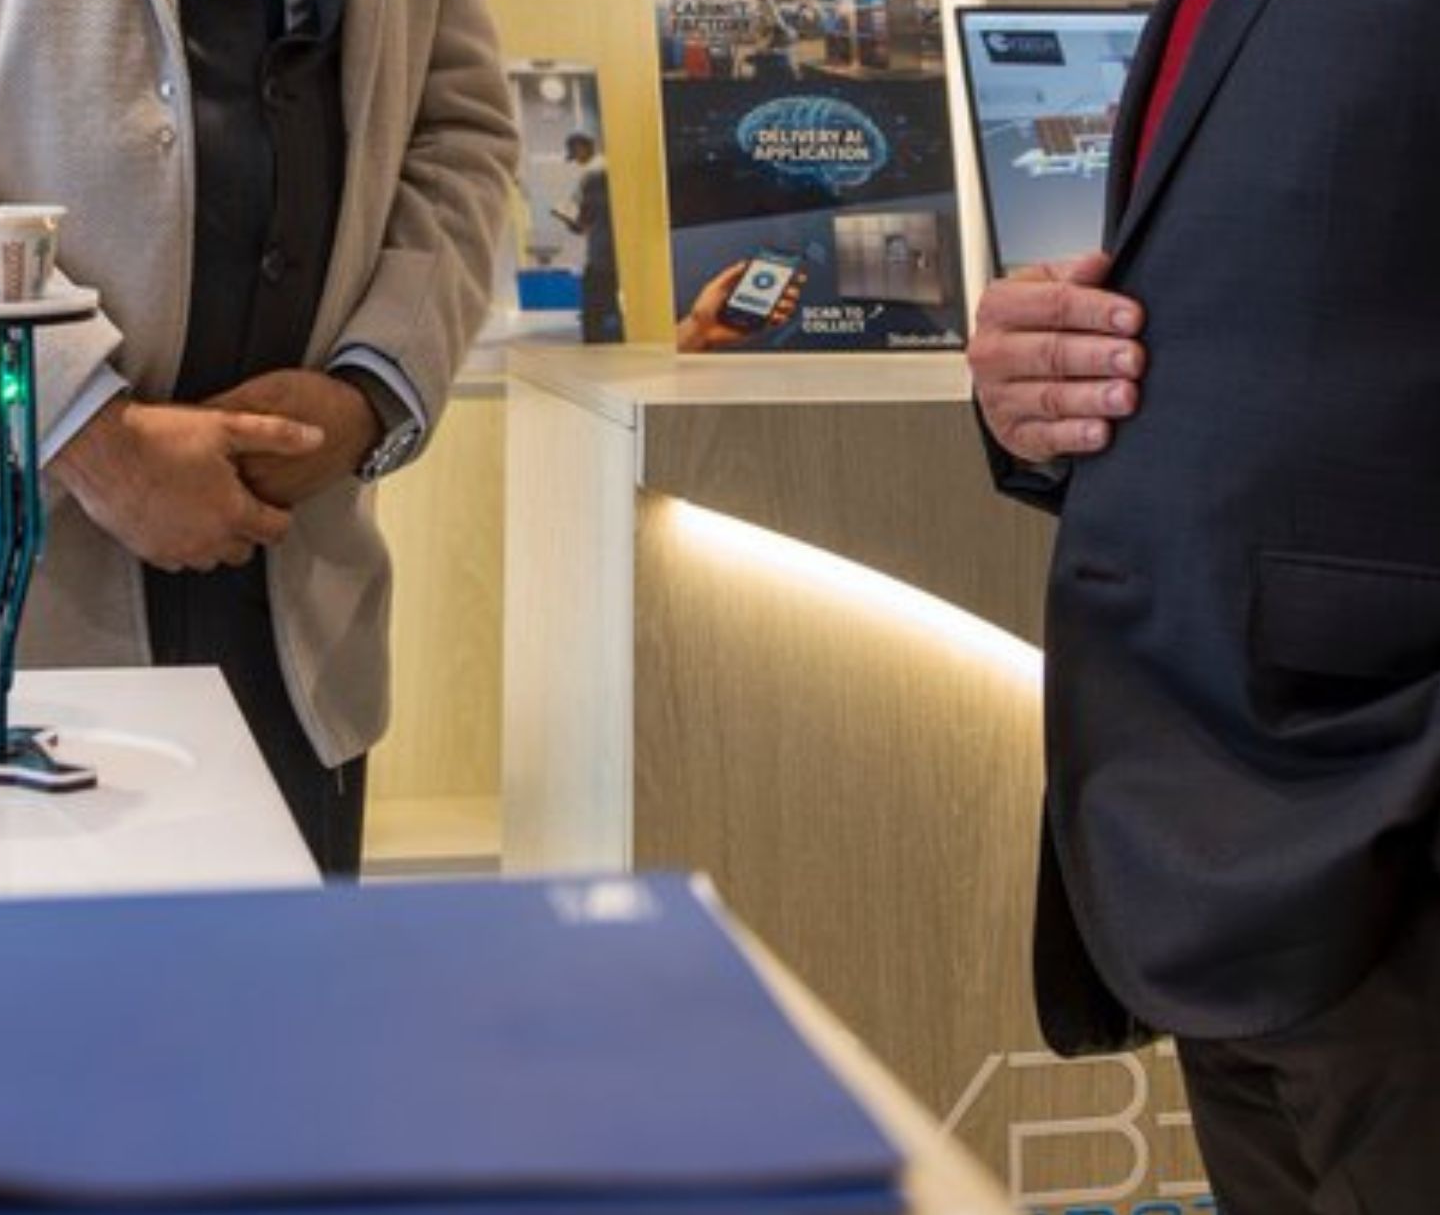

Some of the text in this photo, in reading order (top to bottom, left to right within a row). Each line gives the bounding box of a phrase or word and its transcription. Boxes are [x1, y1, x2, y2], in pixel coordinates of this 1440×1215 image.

[759, 129, 839, 143] DELIVERY
[754, 144, 868, 160] APPLICATION
[802, 306, 864, 319] SCAN TO
[802, 320, 864, 333] COLLECT
